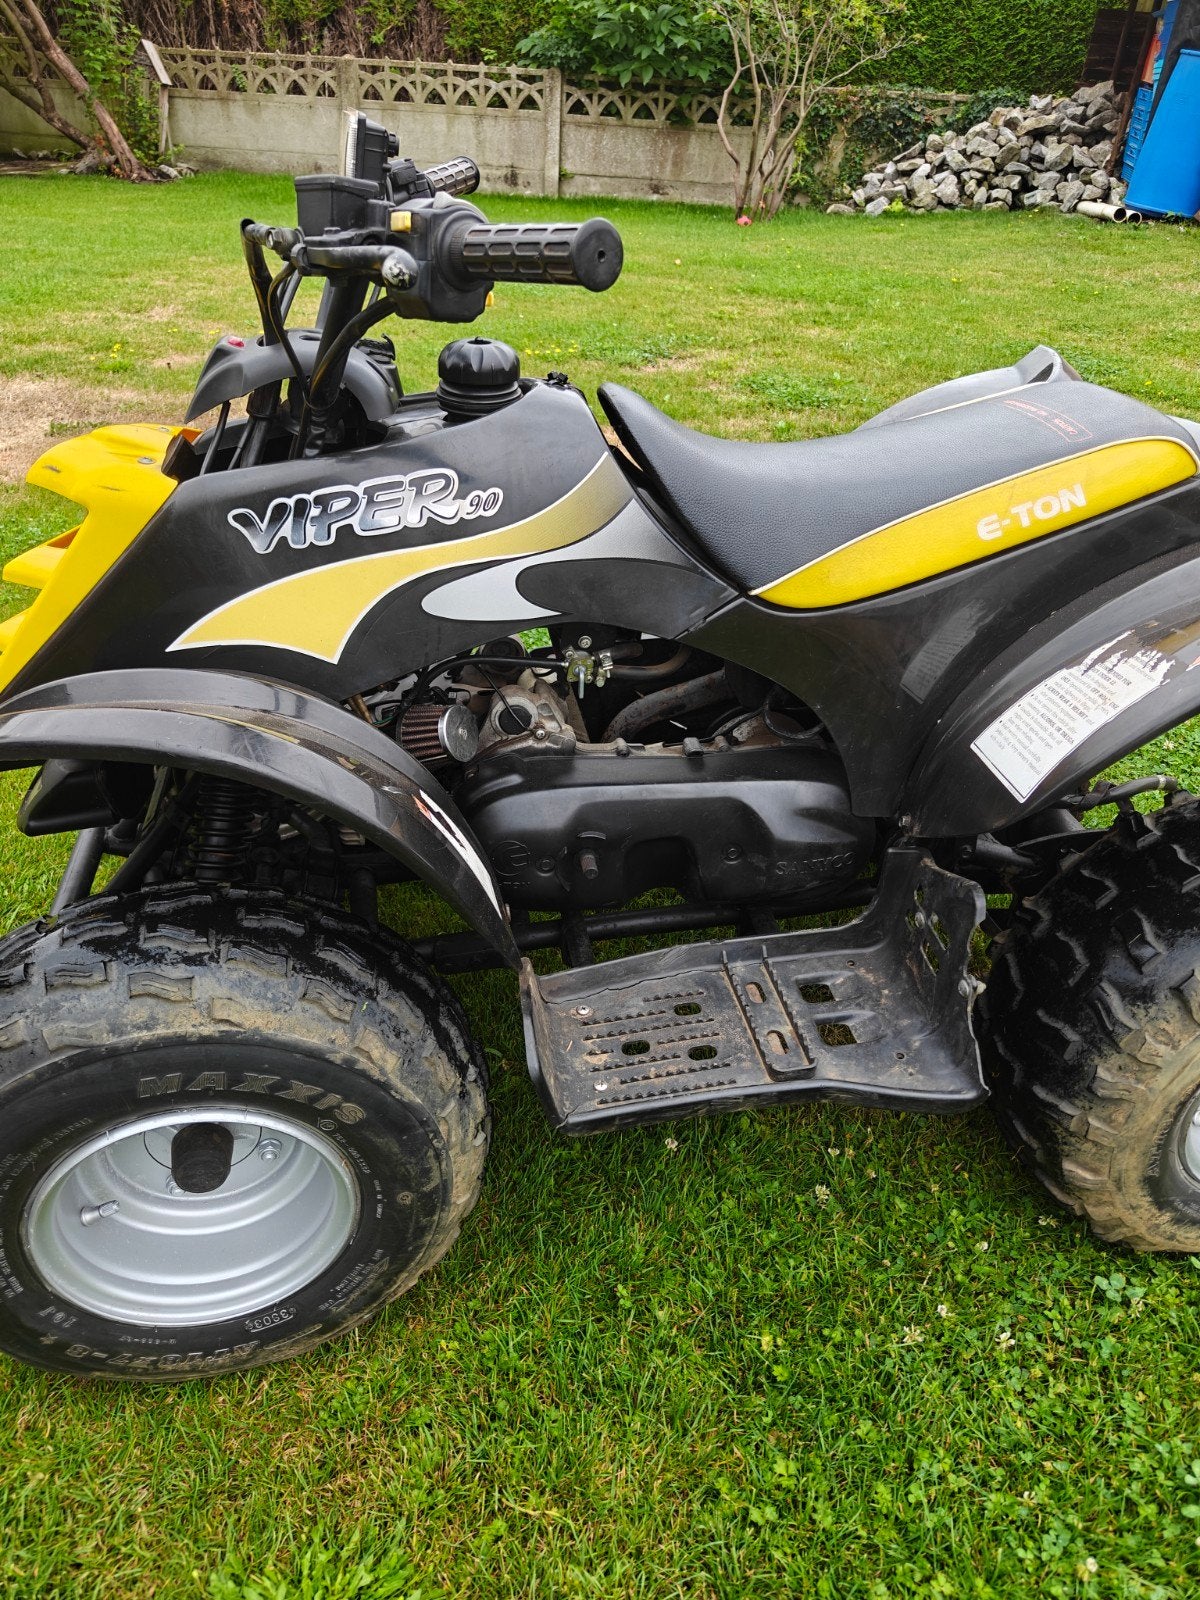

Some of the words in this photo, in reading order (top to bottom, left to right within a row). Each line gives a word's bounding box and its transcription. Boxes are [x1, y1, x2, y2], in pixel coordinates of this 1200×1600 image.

[227, 468, 459, 554] VIPER
[459, 487, 504, 520] 90
[976, 482, 1087, 541] E-TON
[138, 1071, 366, 1125] MAXXIS
